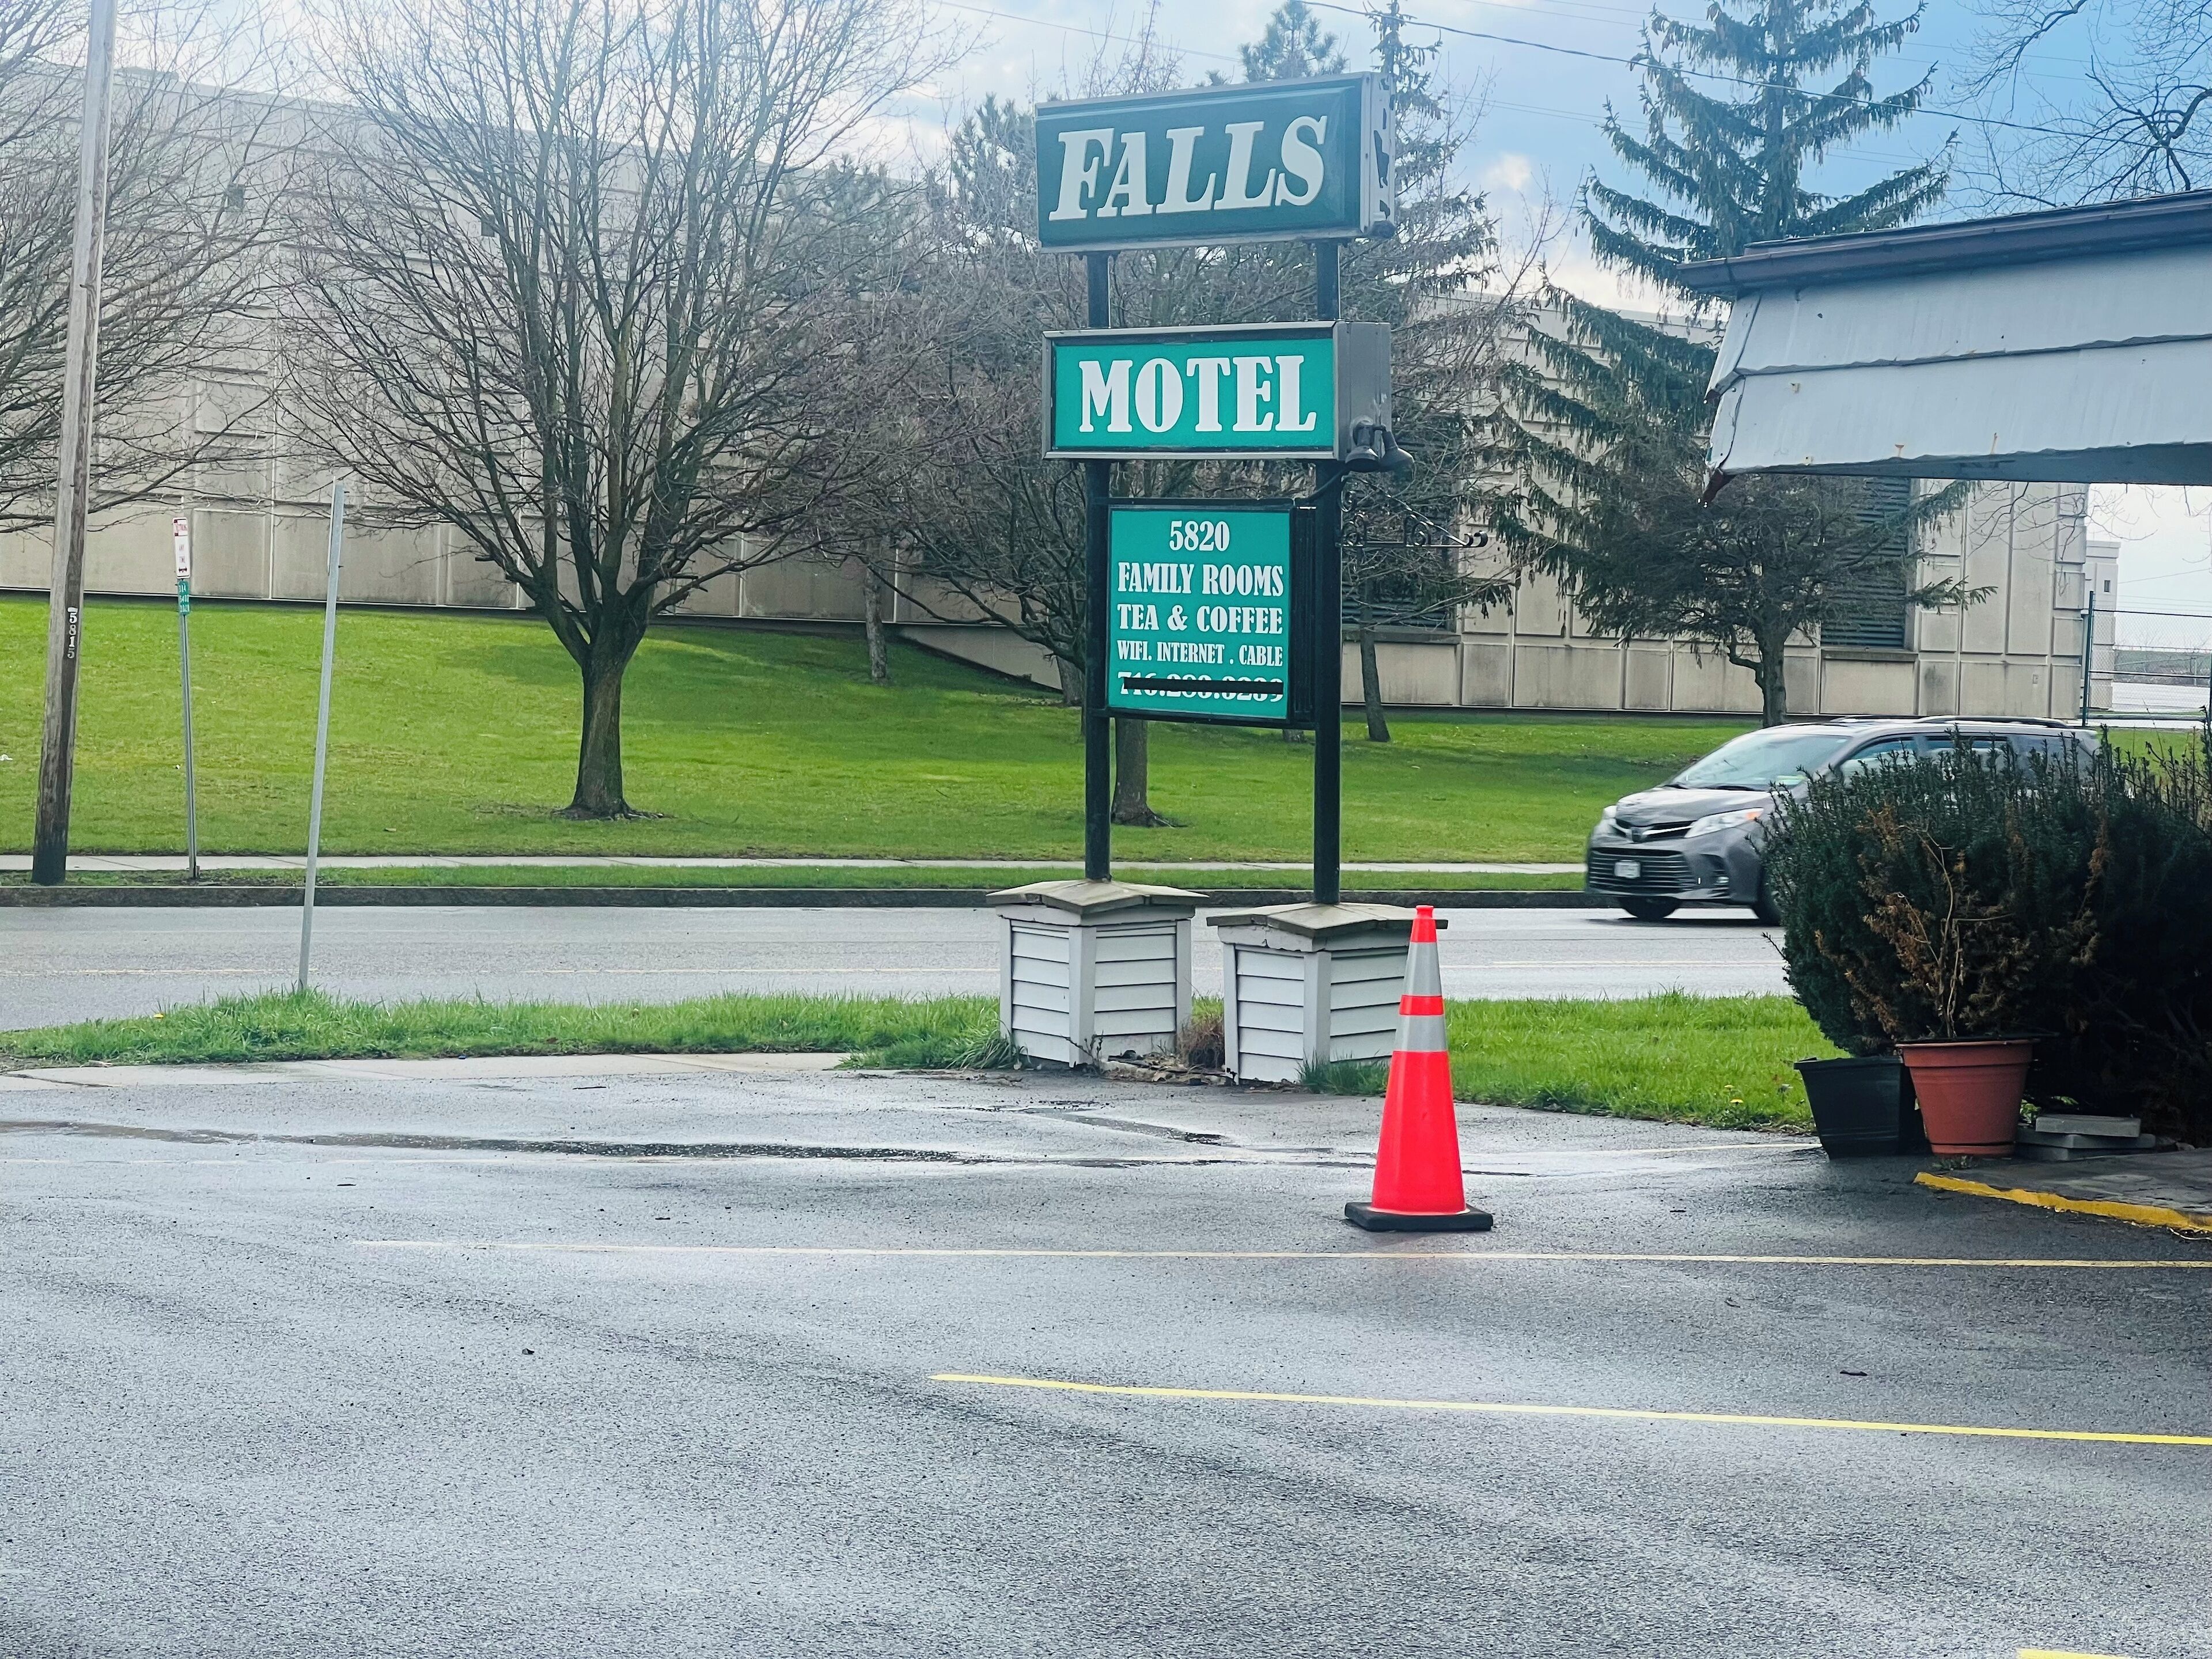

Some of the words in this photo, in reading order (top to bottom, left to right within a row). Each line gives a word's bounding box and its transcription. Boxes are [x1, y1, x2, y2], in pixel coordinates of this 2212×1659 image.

[1048, 115, 1327, 221] FALLS
[1079, 355, 1317, 433] MOTEL
[1169, 520, 1230, 551] 5820
[1118, 562, 1194, 594] FAMILY
[1202, 564, 1283, 596] ROOMS
[67, 611, 78, 659] 5815
[1117, 604, 1159, 630] TEA
[1167, 605, 1188, 631] &
[1196, 606, 1283, 634] COFFEE
[1117, 640, 1152, 661] WIFI.
[1157, 642, 1225, 664] INTERNET
[1238, 645, 1283, 666] CABLE
